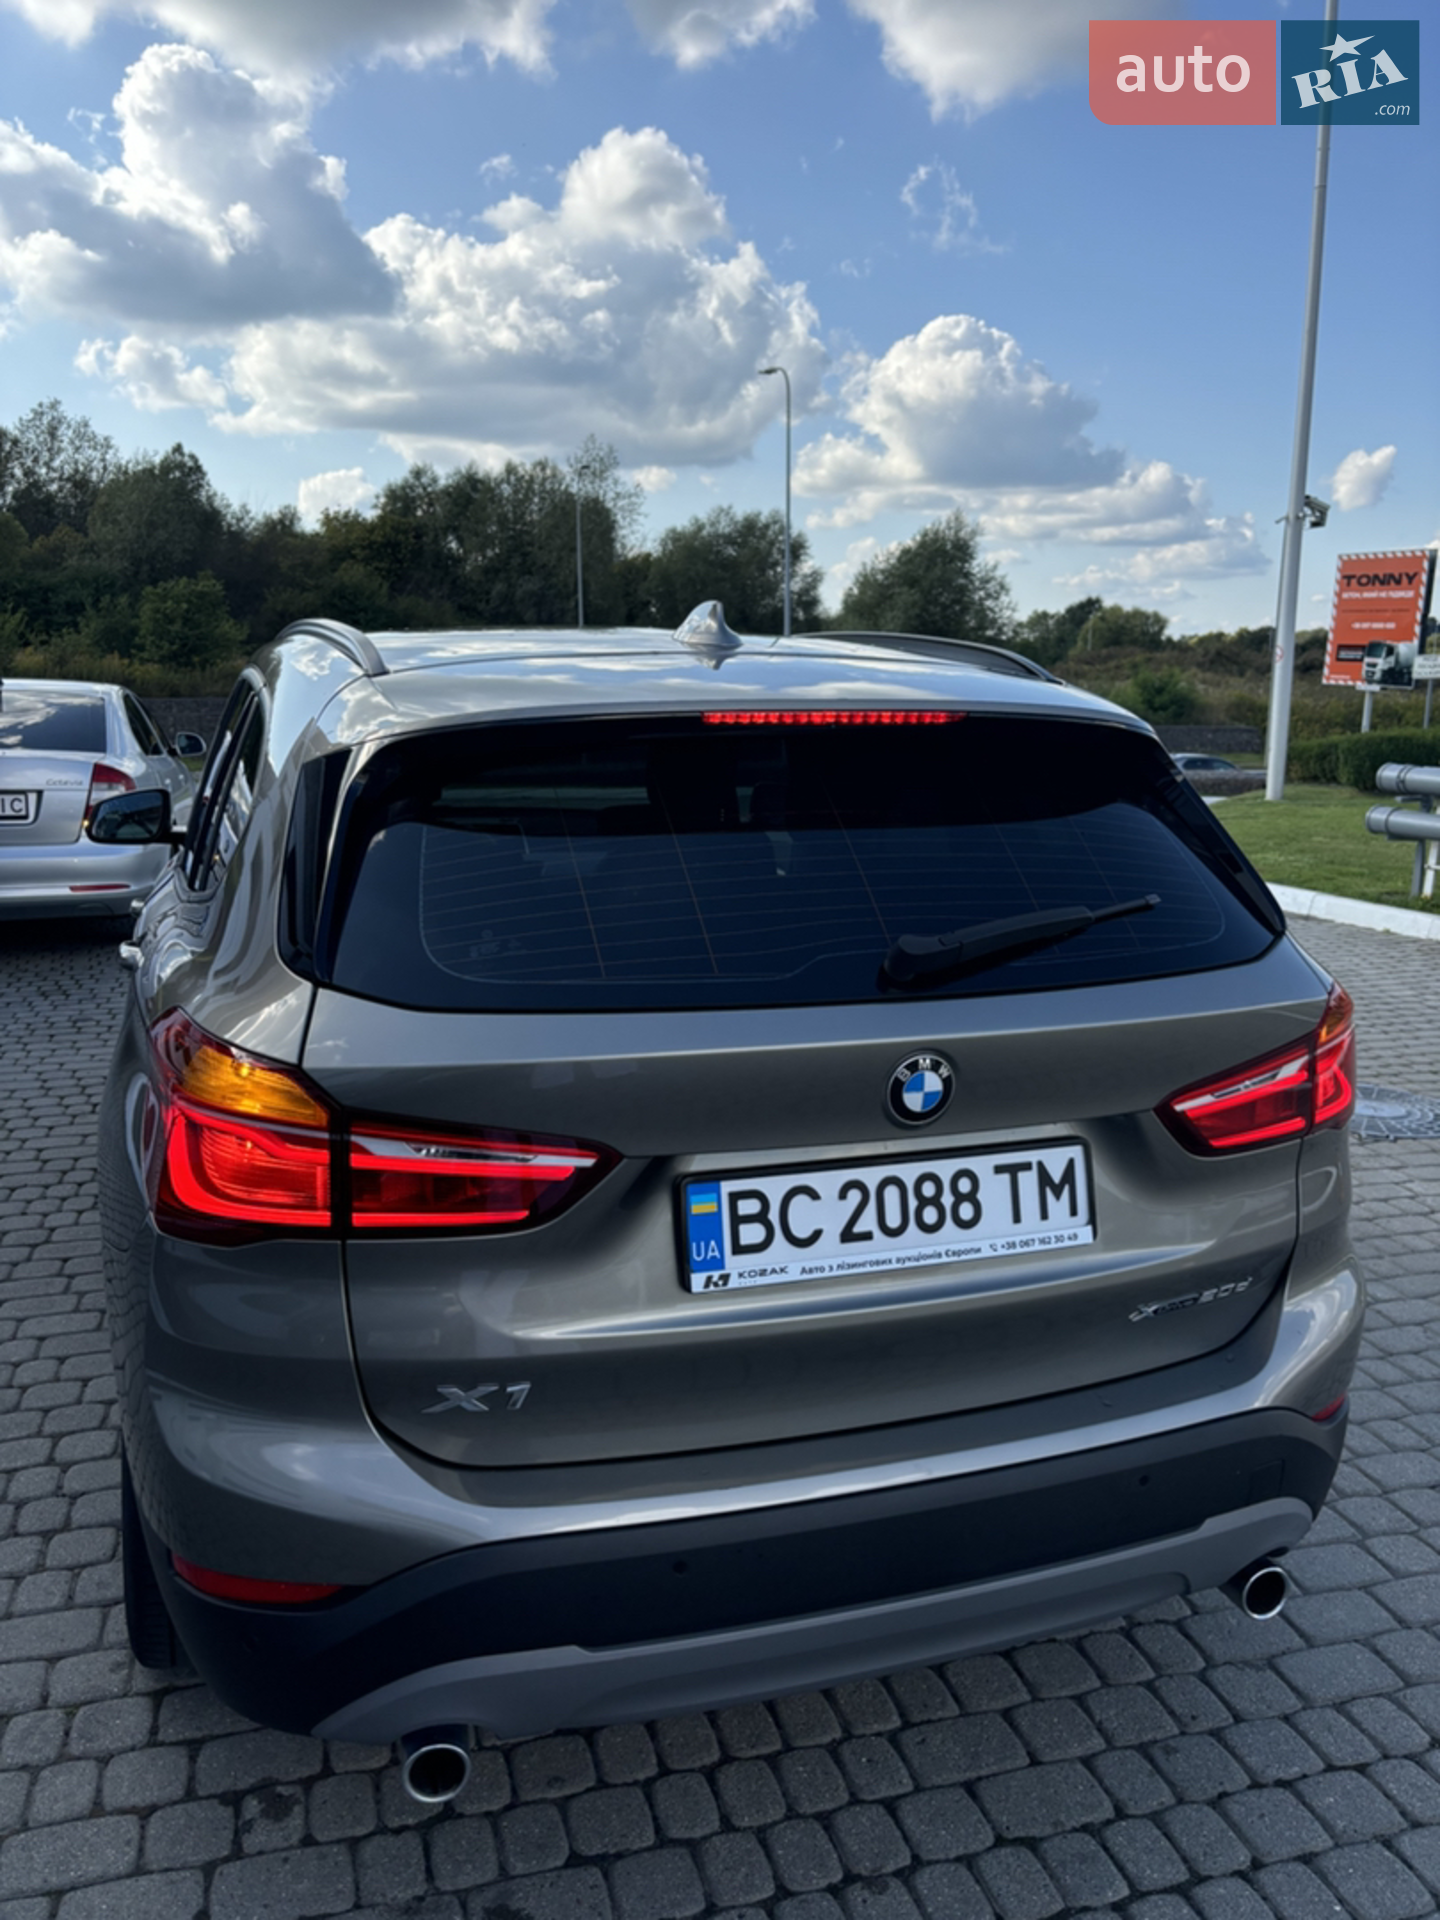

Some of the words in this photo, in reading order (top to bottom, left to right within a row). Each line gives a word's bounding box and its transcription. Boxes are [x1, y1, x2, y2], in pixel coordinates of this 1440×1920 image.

[1341, 571, 1419, 588] TONNY
[727, 1184, 824, 1256] BC
[837, 1167, 983, 1244] 2088
[993, 1156, 1079, 1225] TM
[692, 1239, 721, 1262] UA
[1000, 1240, 1018, 1251] +38
[1018, 1237, 1036, 1249] 067
[737, 1265, 790, 1280] KOZAK
[799, 1264, 827, 1277] Авто
[421, 1381, 532, 1414] X1
